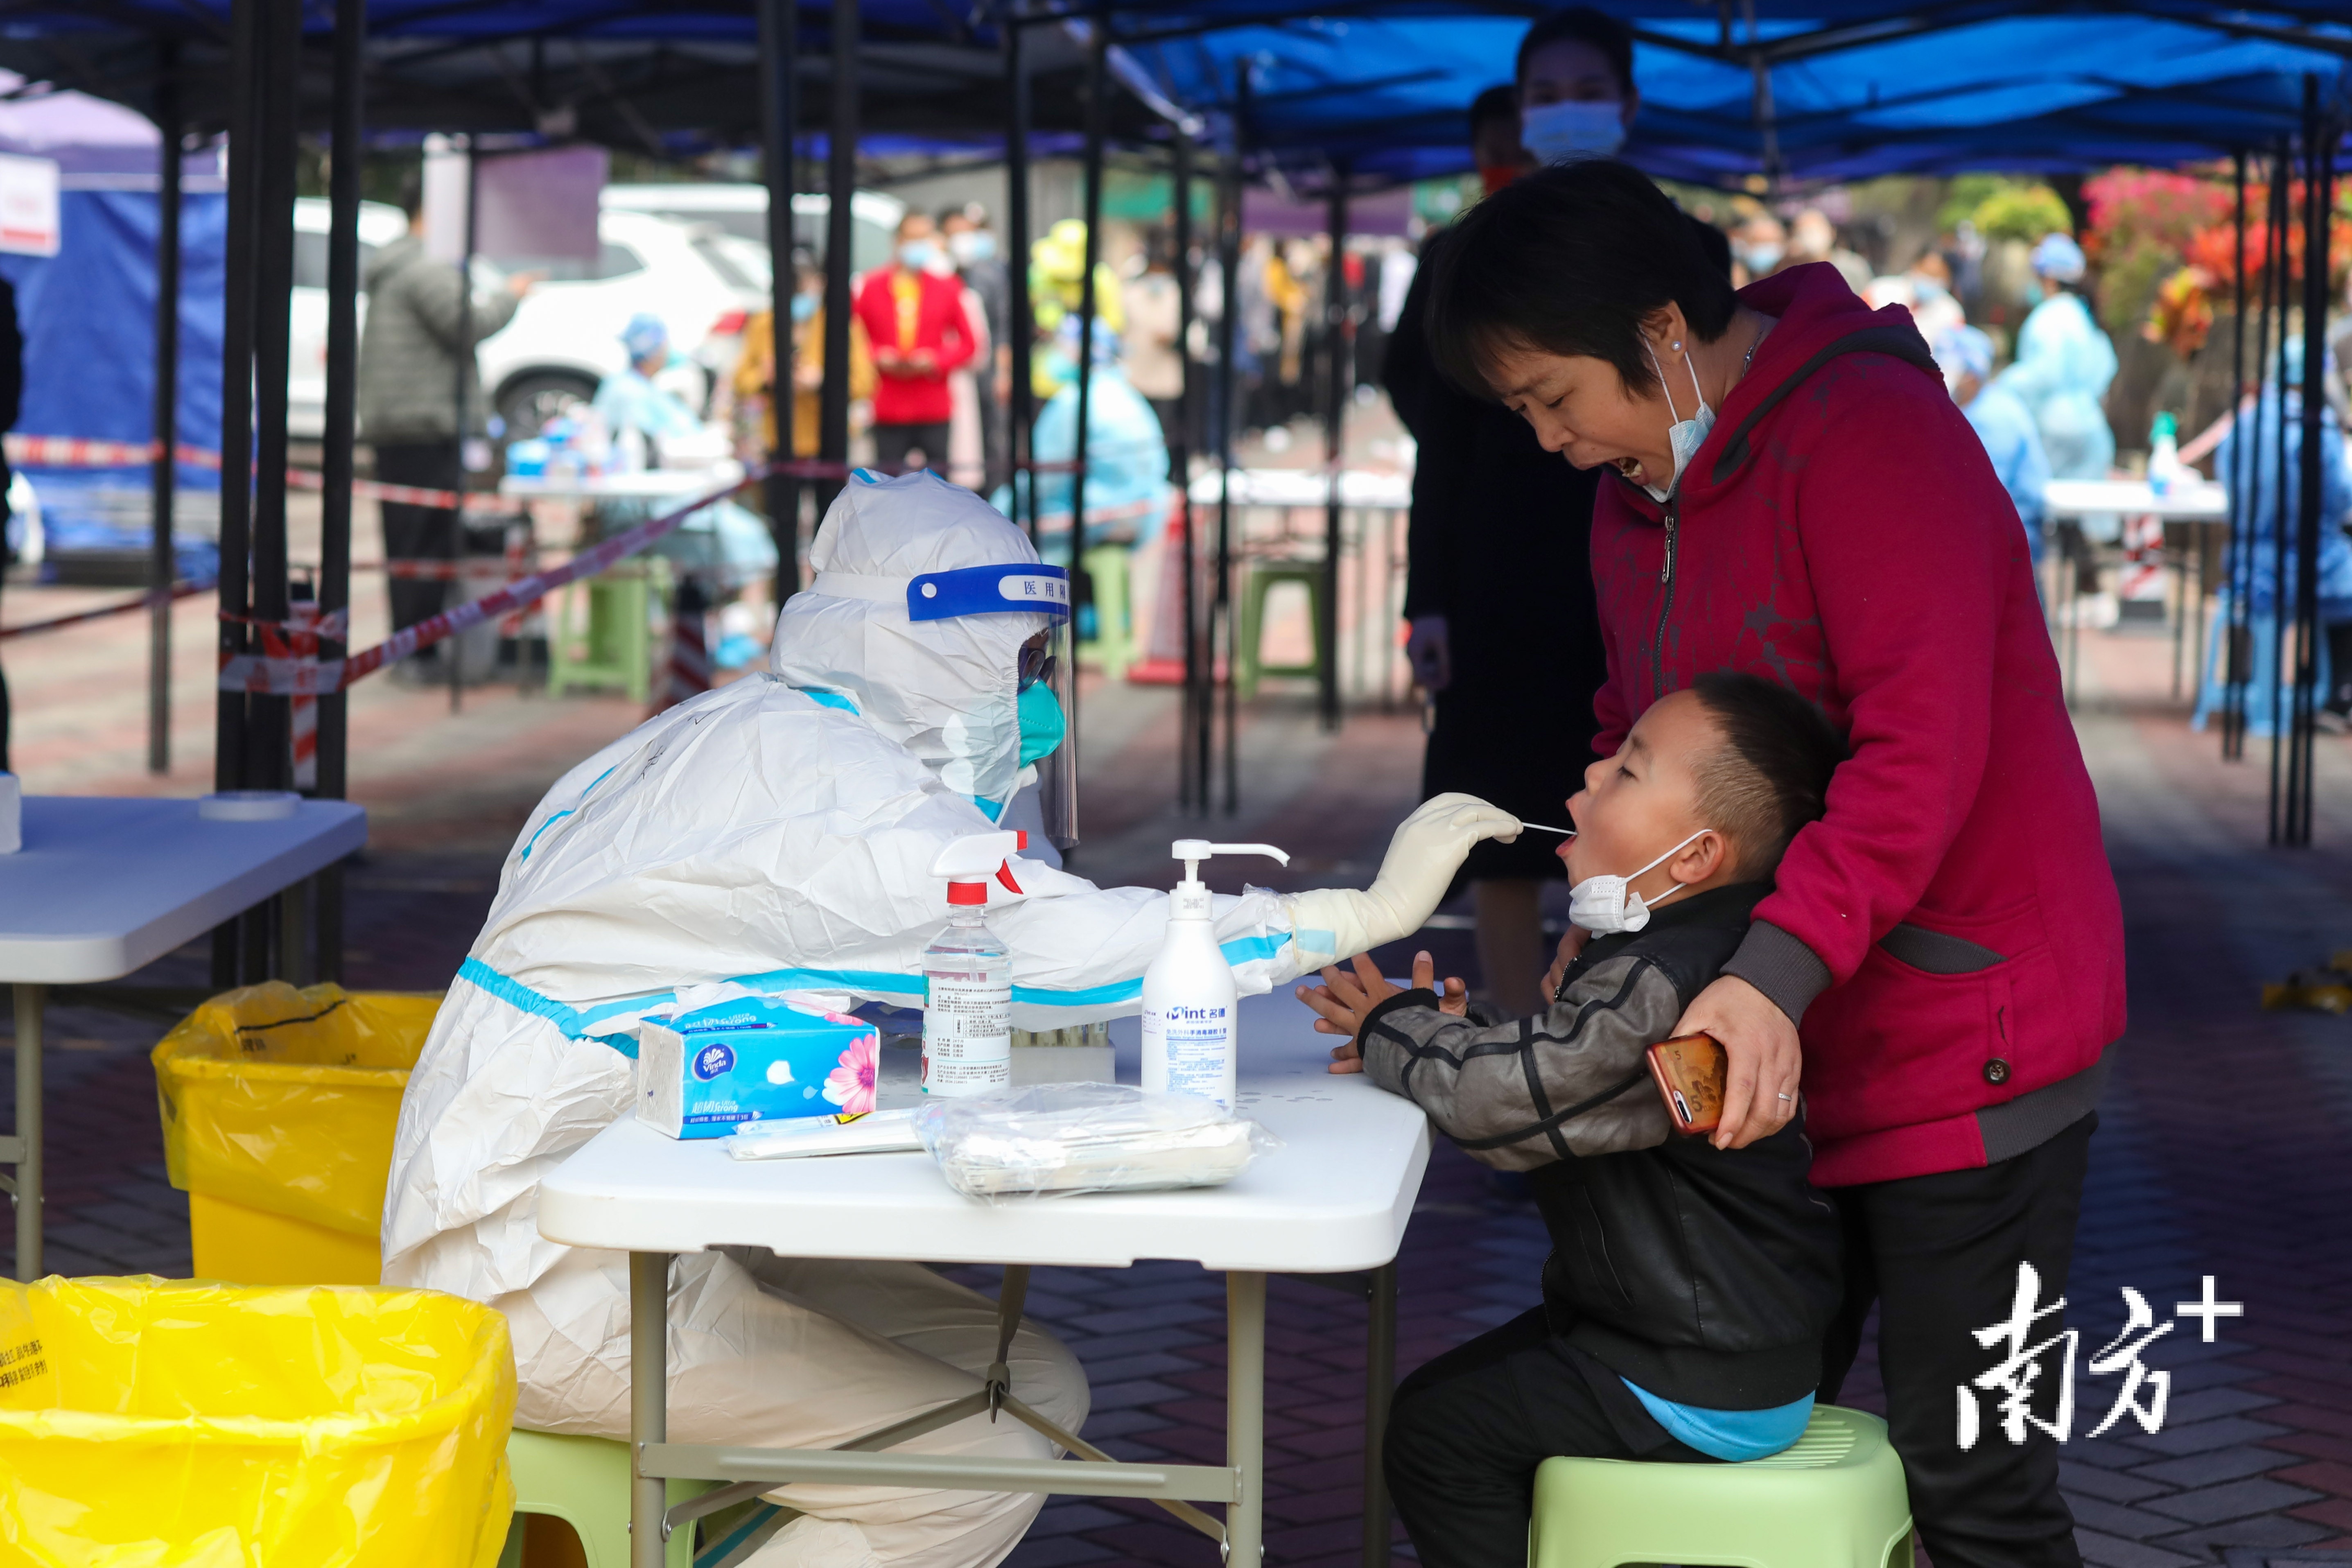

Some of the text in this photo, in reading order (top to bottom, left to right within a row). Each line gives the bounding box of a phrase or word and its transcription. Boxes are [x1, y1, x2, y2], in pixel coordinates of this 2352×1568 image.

[1674, 1050, 1681, 1060] 5
[703, 1060, 726, 1072] Vinda
[1690, 1095, 1703, 1112] 5
